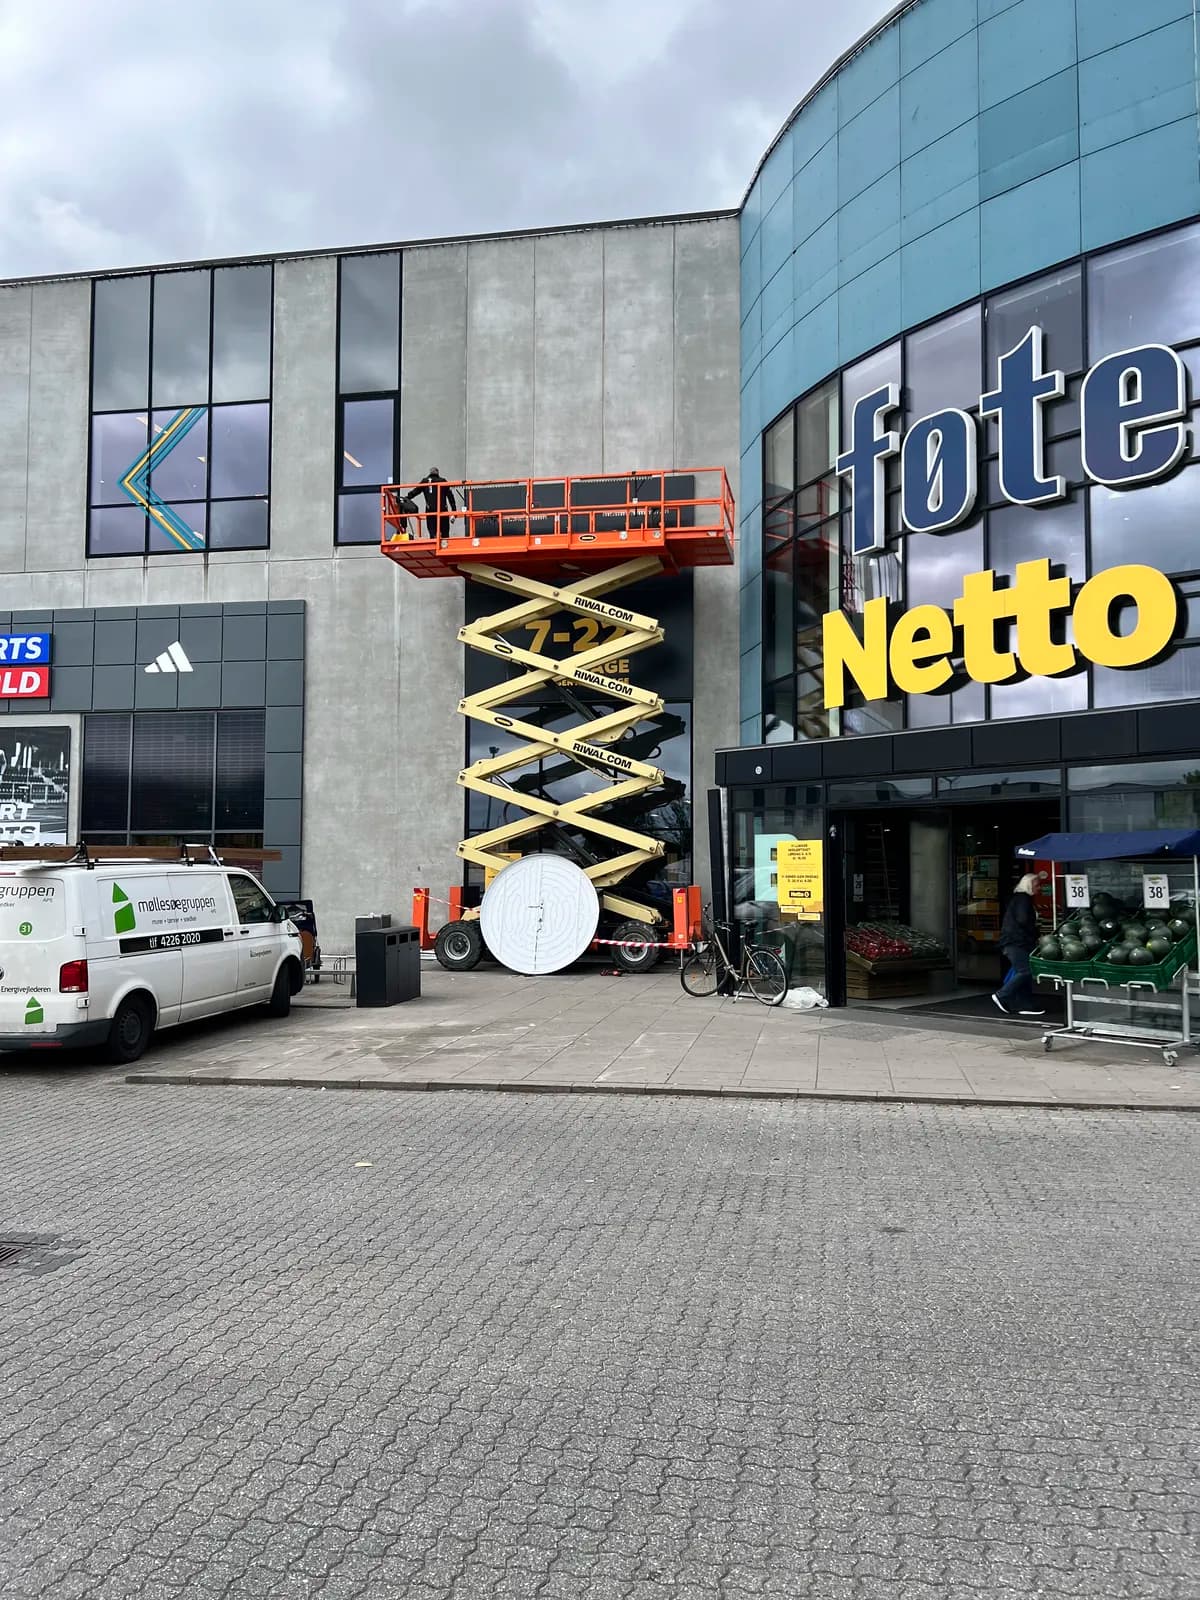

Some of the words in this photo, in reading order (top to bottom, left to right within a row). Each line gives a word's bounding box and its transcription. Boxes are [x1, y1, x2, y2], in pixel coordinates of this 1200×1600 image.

[823, 558, 1177, 709] Netto
[160, 934, 180, 947] 4226
[181, 932, 201, 944] 2020
